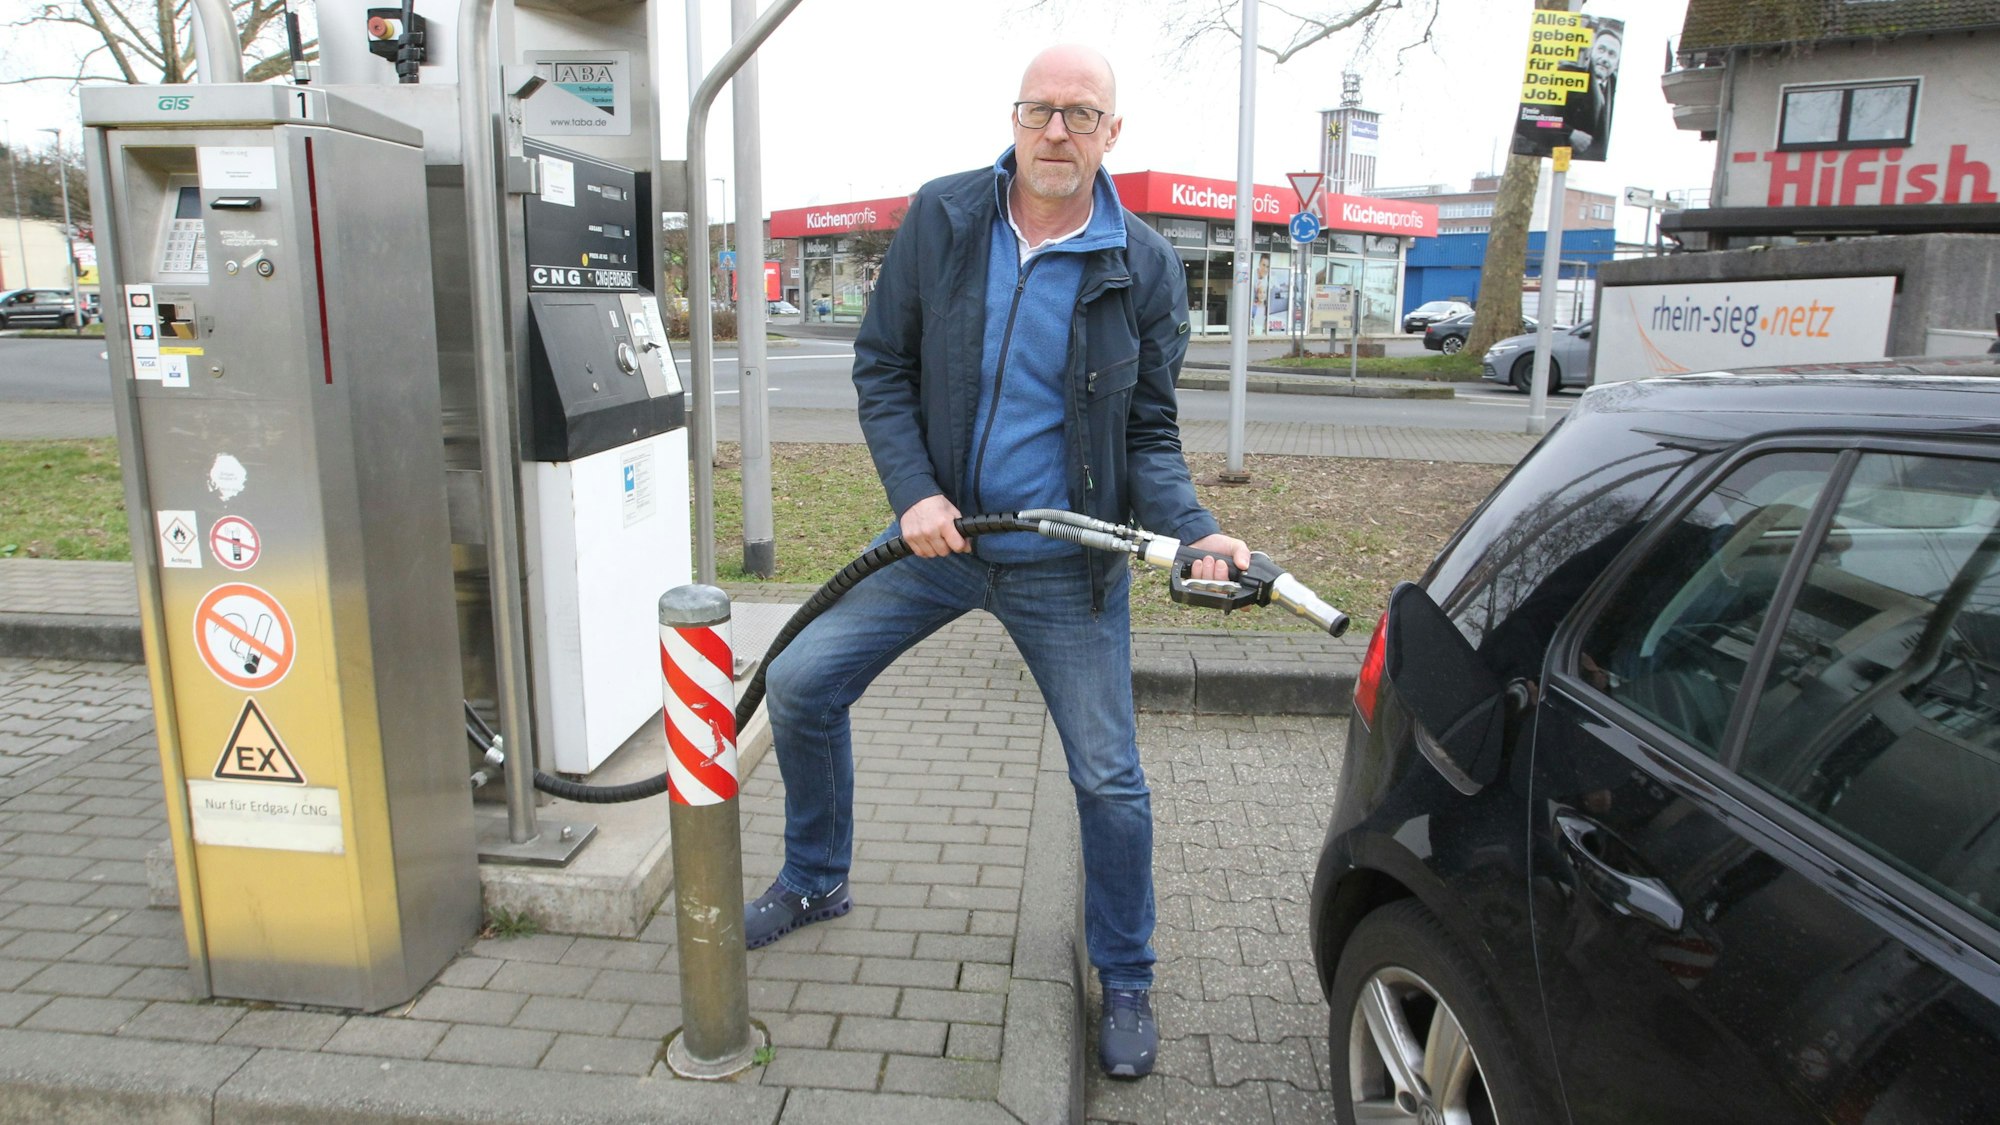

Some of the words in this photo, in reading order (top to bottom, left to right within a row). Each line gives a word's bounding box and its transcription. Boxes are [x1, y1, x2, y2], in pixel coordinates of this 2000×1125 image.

[1535, 13, 1577, 27] Alles
[1532, 29, 1589, 43] geben.
[1531, 44, 1575, 57] Auch
[1529, 58, 1554, 70] für
[1526, 73, 1584, 88] Deinen
[1524, 88, 1562, 101] Job.
[158, 95, 194, 111] GTS
[296, 92, 307, 118] 1
[550, 118, 607, 126] www.taba.de
[1763, 144, 1998, 207] HiFish
[806, 207, 877, 229] Küchenprofis
[1342, 202, 1424, 229] Küchenprofis
[1163, 227, 1203, 239] nobilia
[533, 268, 581, 286] CNG
[236, 746, 279, 773] EX
[205, 798, 226, 810] Nur
[230, 799, 247, 811] für
[250, 801, 290, 816] Erdgas
[301, 804, 328, 816] CNG
